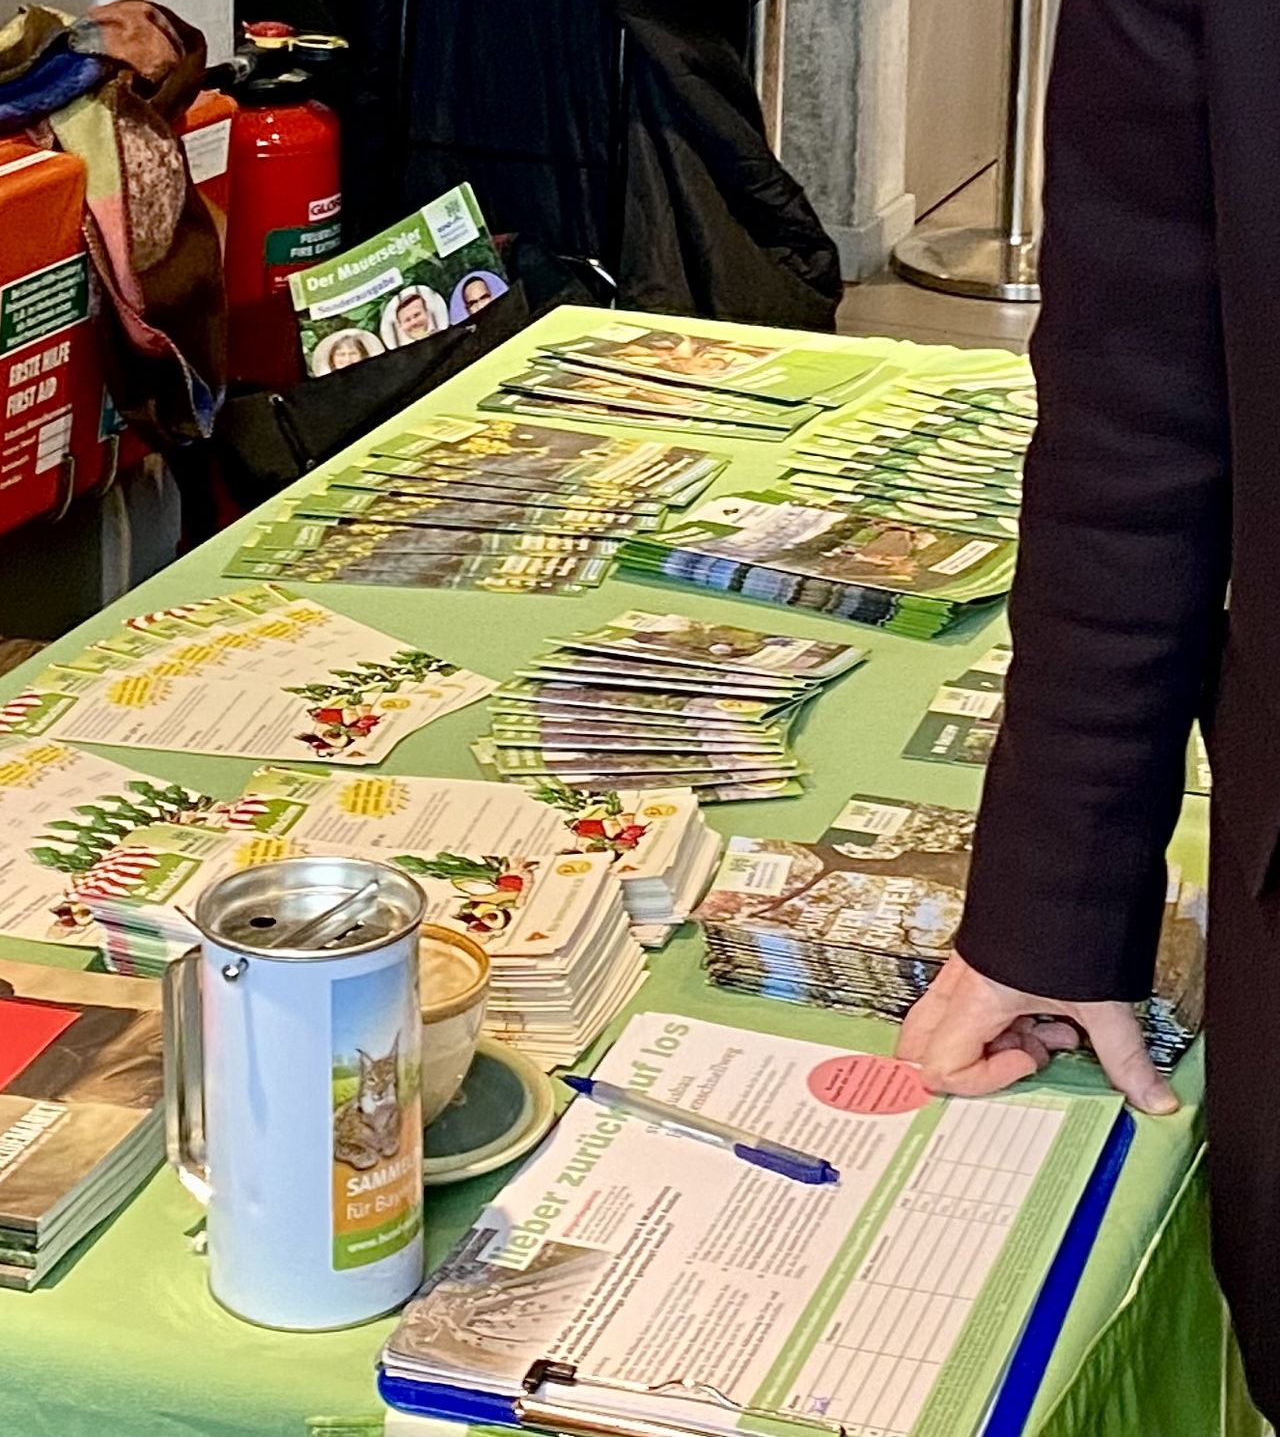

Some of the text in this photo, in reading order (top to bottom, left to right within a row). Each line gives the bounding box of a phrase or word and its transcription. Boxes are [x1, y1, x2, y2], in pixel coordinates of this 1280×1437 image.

[306, 272, 334, 292] Der
[336, 227, 422, 281] Mauersegler
[6, 376, 58, 419] FIRST AID
[666, 1075, 695, 1106] usbau
[487, 1189, 569, 1263] lieber
[641, 1021, 690, 1059] los
